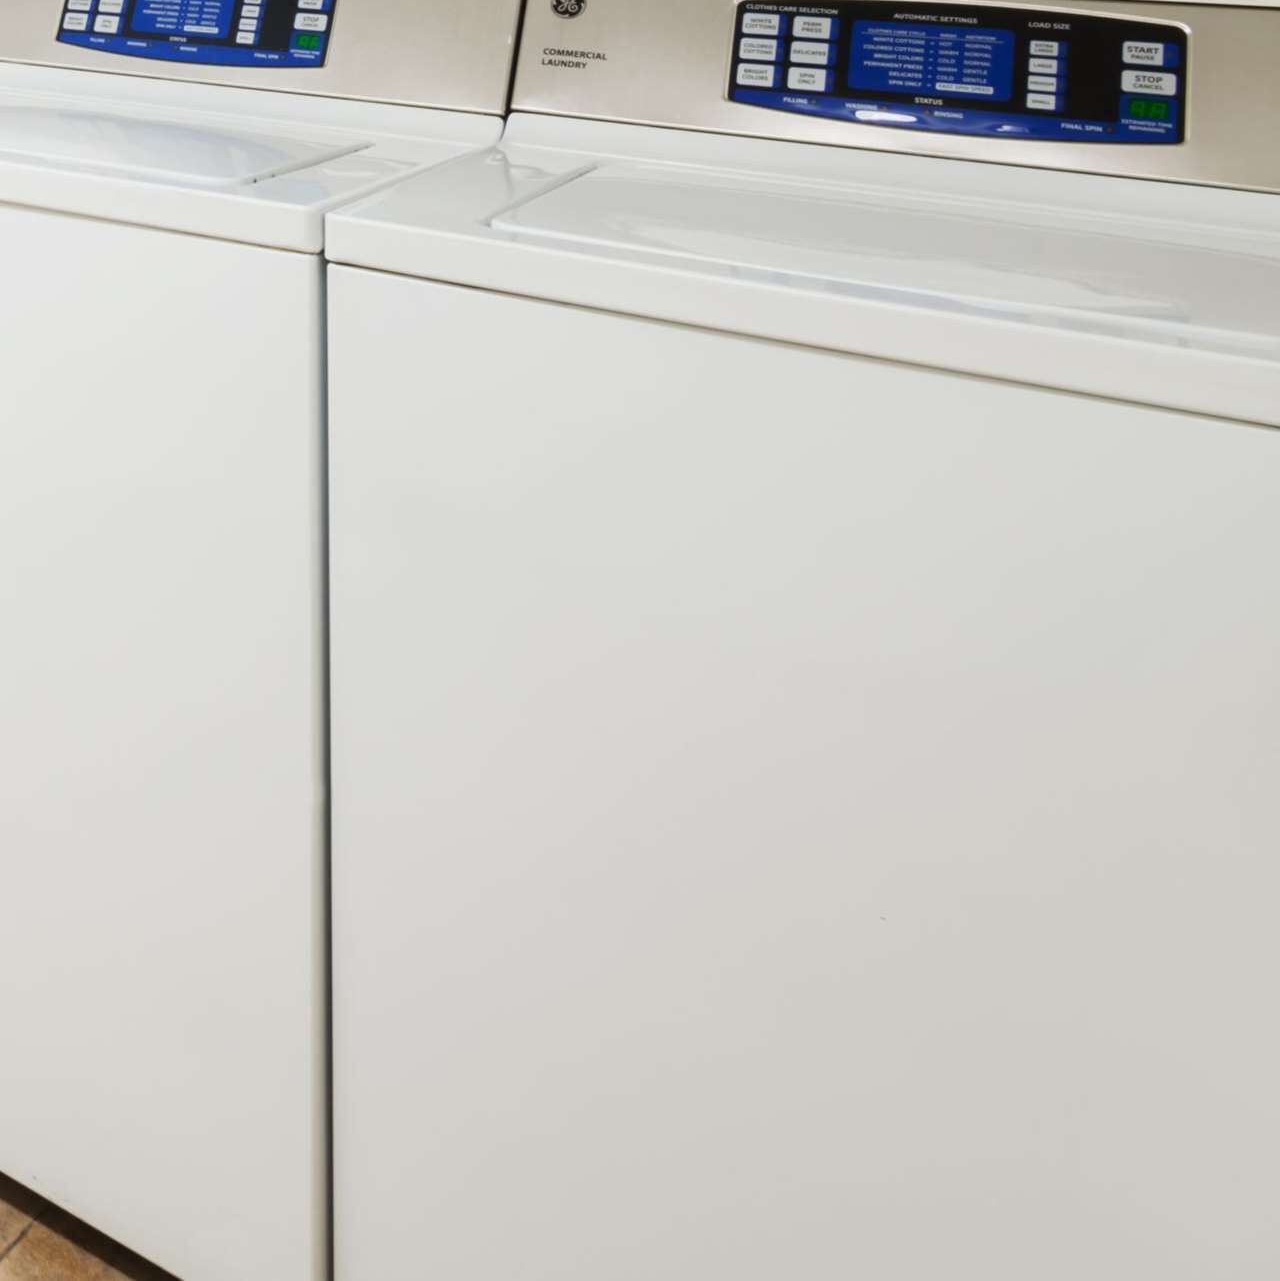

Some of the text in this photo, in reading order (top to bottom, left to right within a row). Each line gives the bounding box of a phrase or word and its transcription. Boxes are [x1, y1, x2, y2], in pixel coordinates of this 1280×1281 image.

[779, 5, 797, 13] CARE
[894, 13, 978, 24] AUTOMATIC SETTINGS
[1028, 21, 1071, 30] LOAD SIZE
[543, 47, 608, 61] COMMERCIAL
[1127, 45, 1160, 54] START
[541, 58, 587, 69] LAUNDRY
[1134, 74, 1163, 84] STOP
[1132, 83, 1164, 91] CANCEL
[783, 96, 808, 104] FILLING
[914, 96, 943, 106] STATUS
[1061, 122, 1103, 132] FINAL SPIN
